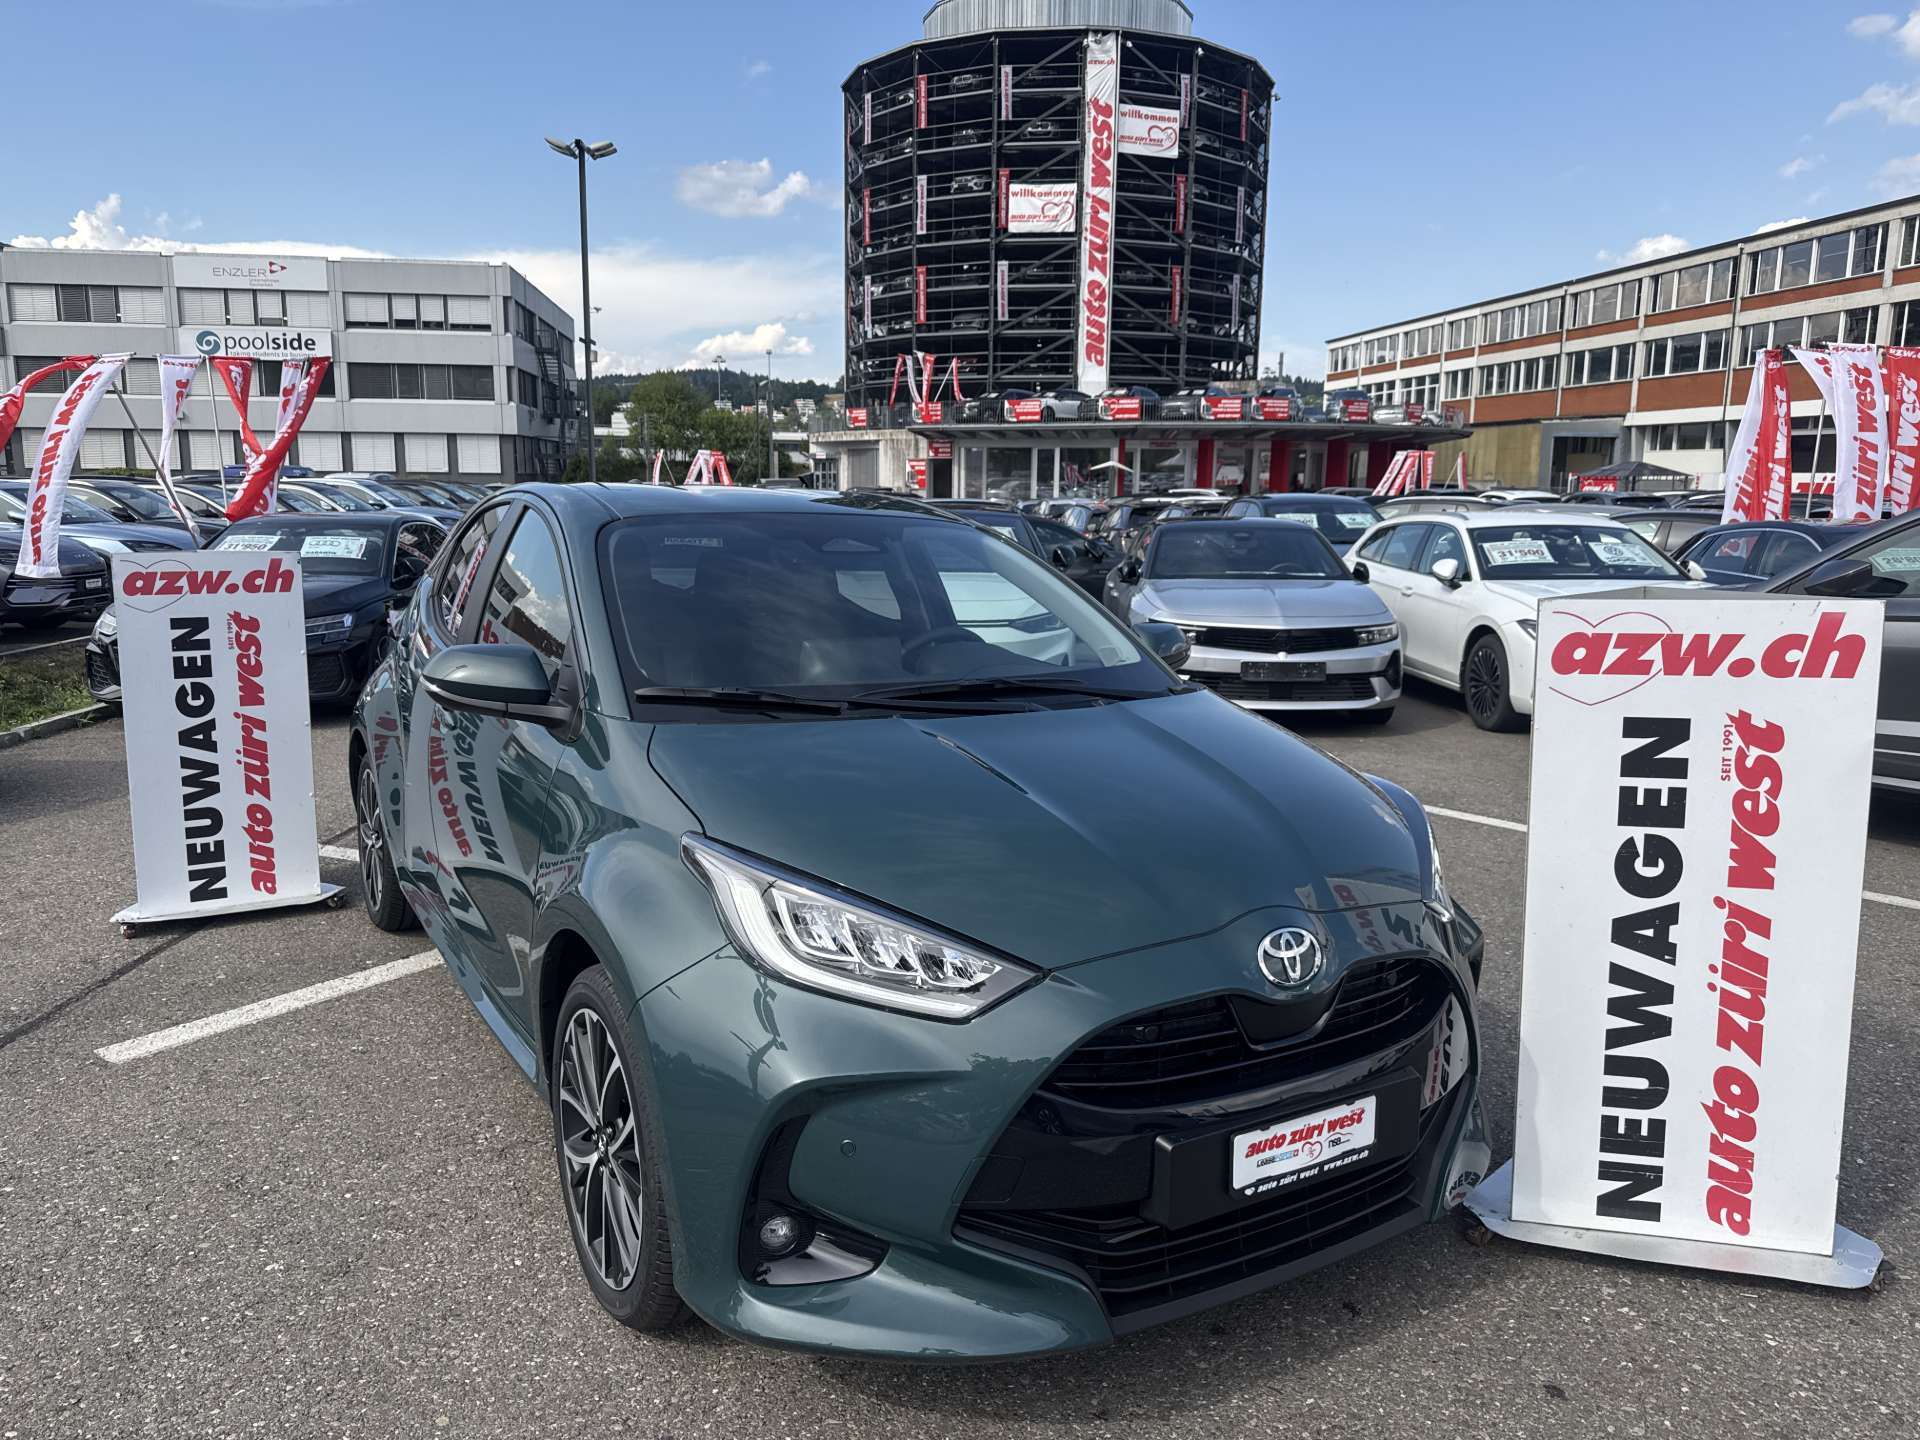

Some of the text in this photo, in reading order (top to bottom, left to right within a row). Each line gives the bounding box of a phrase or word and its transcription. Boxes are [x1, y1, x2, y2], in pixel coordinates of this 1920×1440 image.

[1120, 109, 1178, 123] willkommen
[1011, 188, 1074, 198] willkommen
[1084, 97, 1114, 367] auto züri west
[212, 266, 267, 277] ENZLER
[224, 332, 317, 356] poolside
[1848, 362, 1880, 511] züri west
[123, 558, 295, 596] azw.ch
[1551, 612, 1867, 679] azw.ch
[170, 616, 229, 903] NEUWAGEN
[227, 610, 277, 896] auto züri west
[1721, 723, 1734, 782] SEIT 1991
[1596, 716, 1692, 1223] NEUWAGEN
[1700, 709, 1786, 1237] auto züri west
[1245, 1130, 1287, 1159] auto
[1287, 1117, 1327, 1146] züri
[1327, 1107, 1366, 1134] west
[1257, 1150, 1370, 1193] auto züri west www.azw.ch
